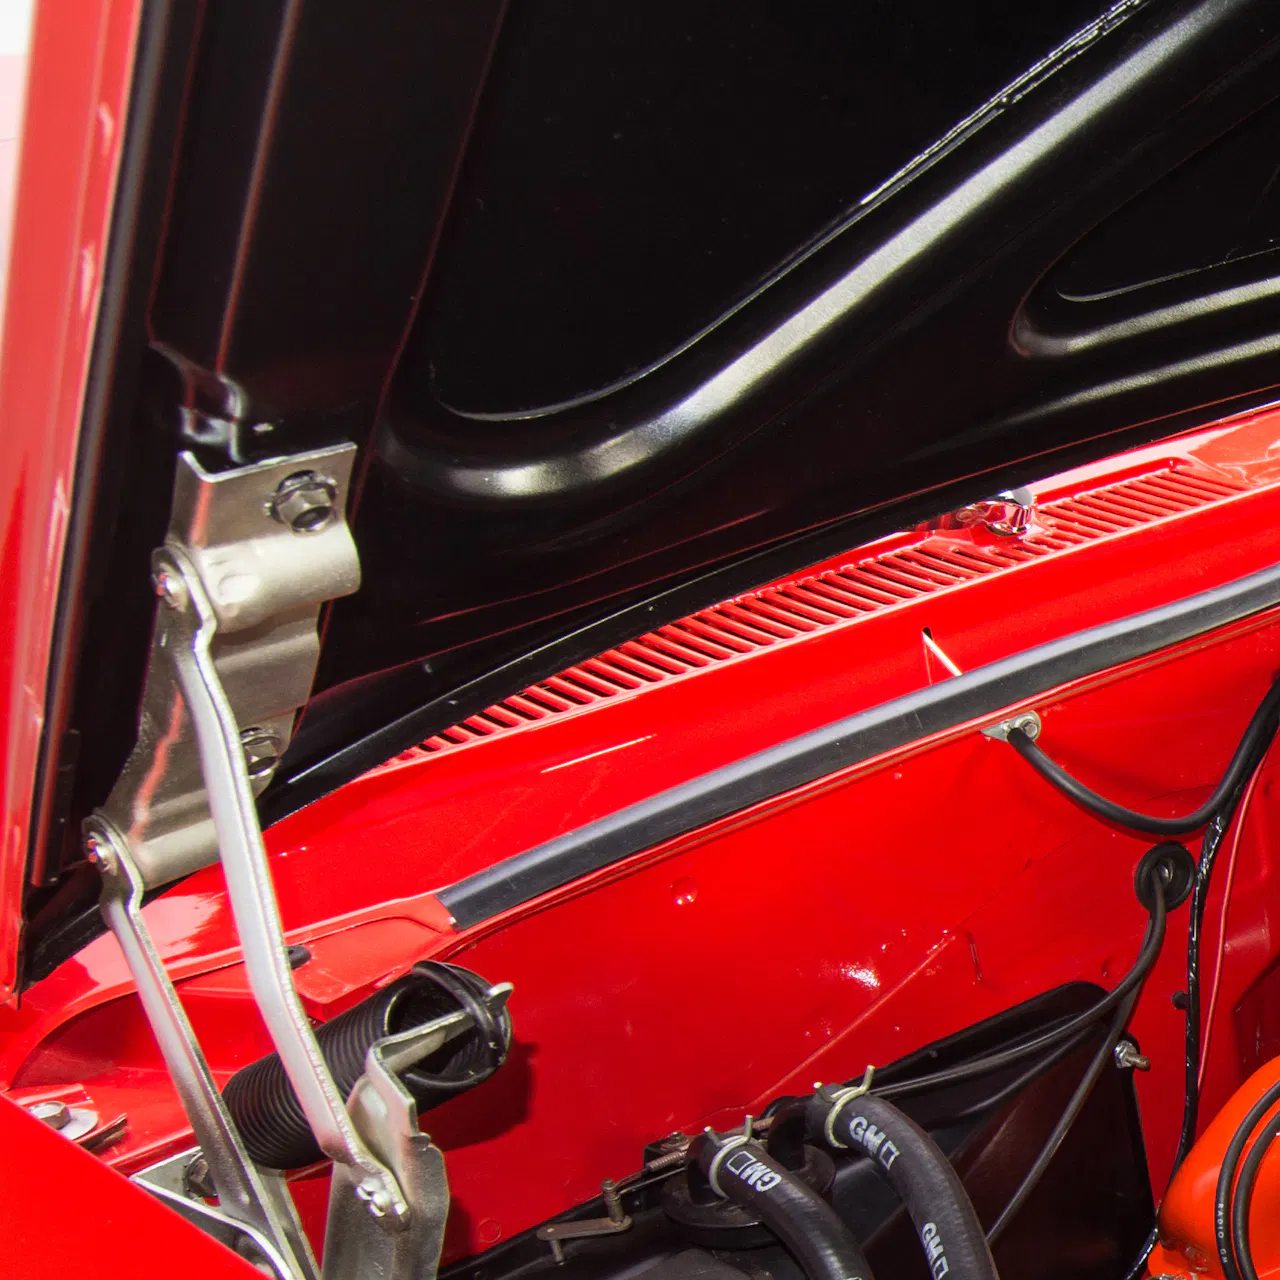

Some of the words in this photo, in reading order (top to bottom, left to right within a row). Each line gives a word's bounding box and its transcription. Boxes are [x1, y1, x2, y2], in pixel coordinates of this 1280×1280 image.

[850, 1116, 887, 1157] GM
[739, 1161, 782, 1192] GM
[1217, 1203, 1225, 1239] RADIO
[922, 1222, 944, 1266] GM
[1220, 1248, 1228, 1264] GM
